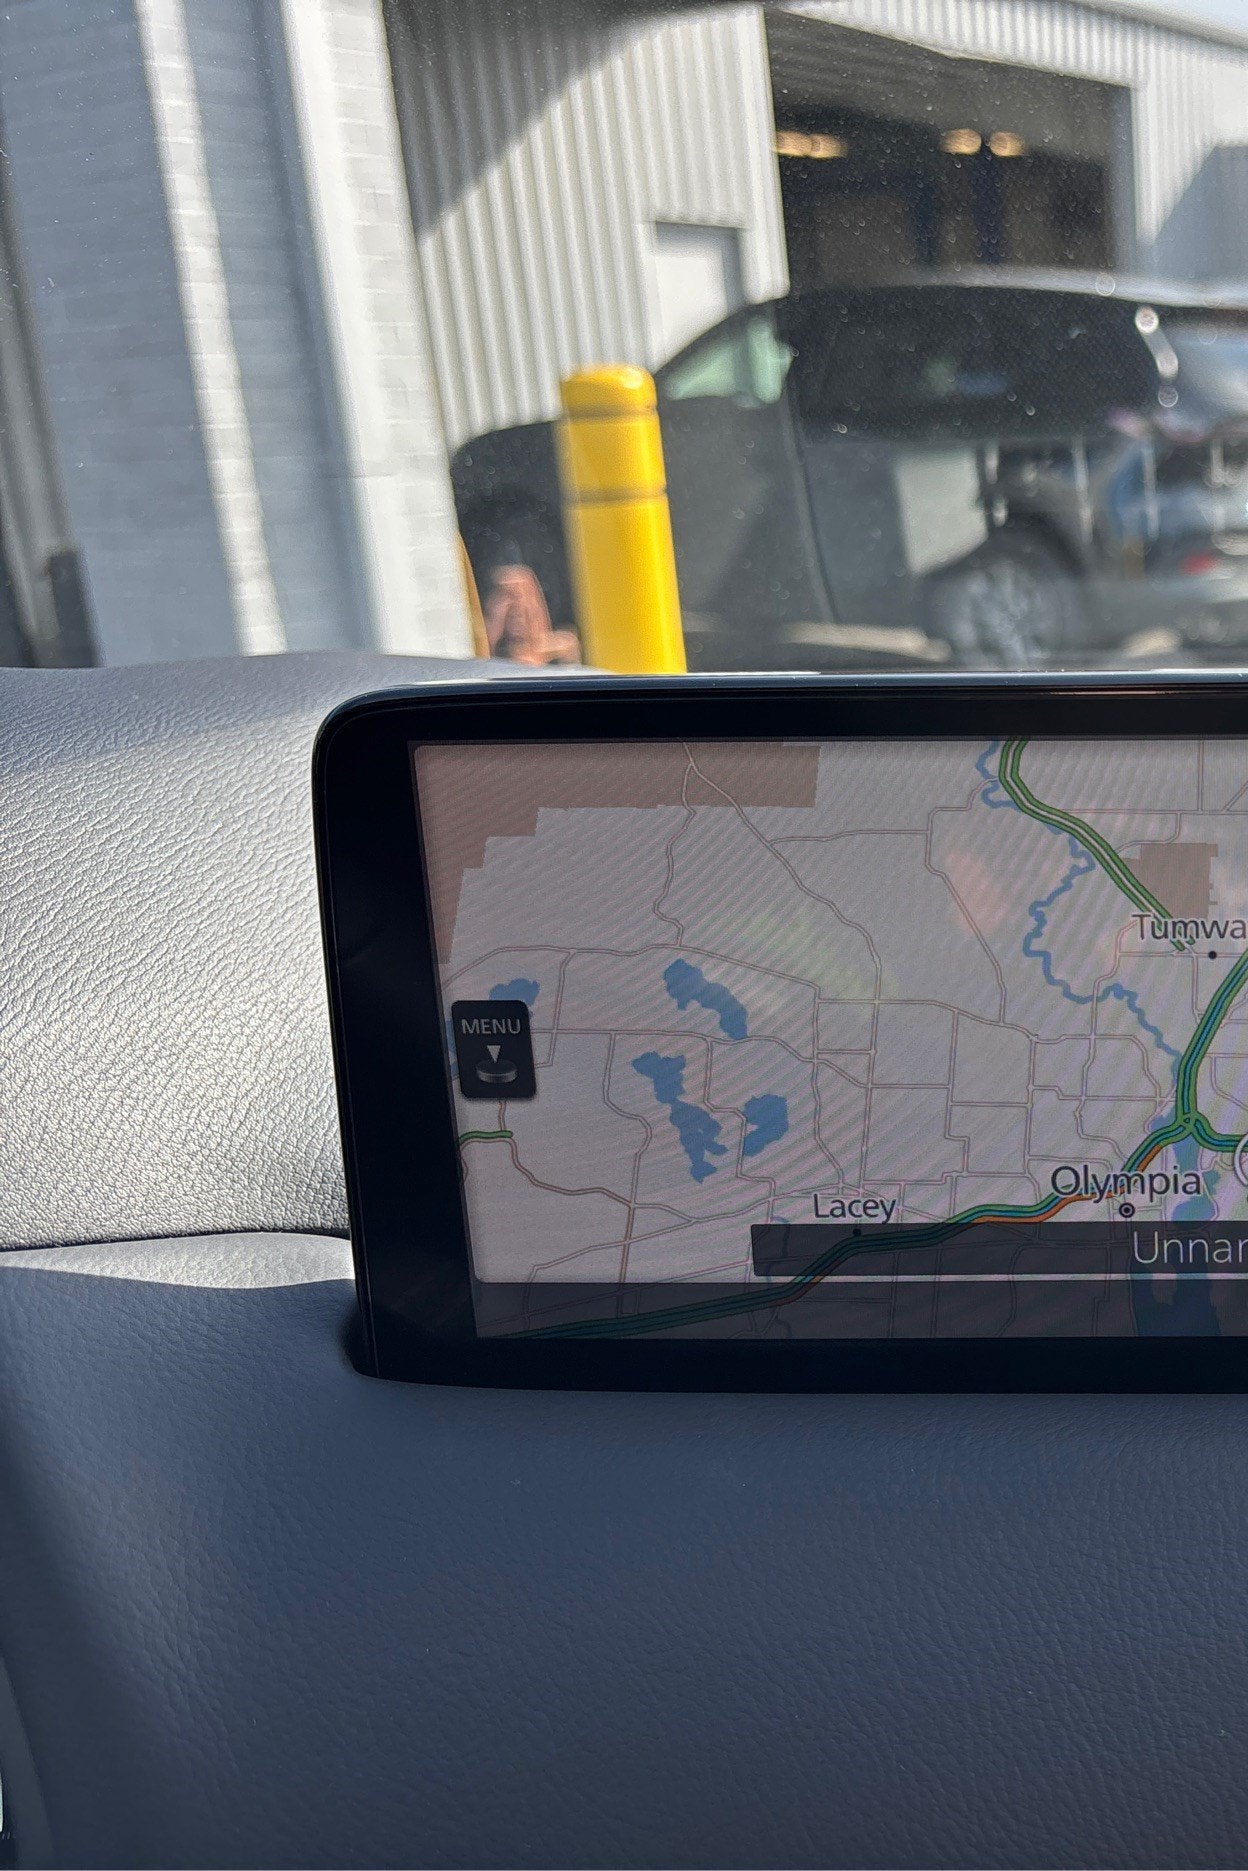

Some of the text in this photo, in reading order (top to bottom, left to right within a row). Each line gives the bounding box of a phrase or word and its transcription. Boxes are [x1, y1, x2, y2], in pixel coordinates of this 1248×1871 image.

[461, 1018, 521, 1035] MENU
[1051, 1165, 1202, 1203] Olympia
[813, 1193, 897, 1224] Lacey
